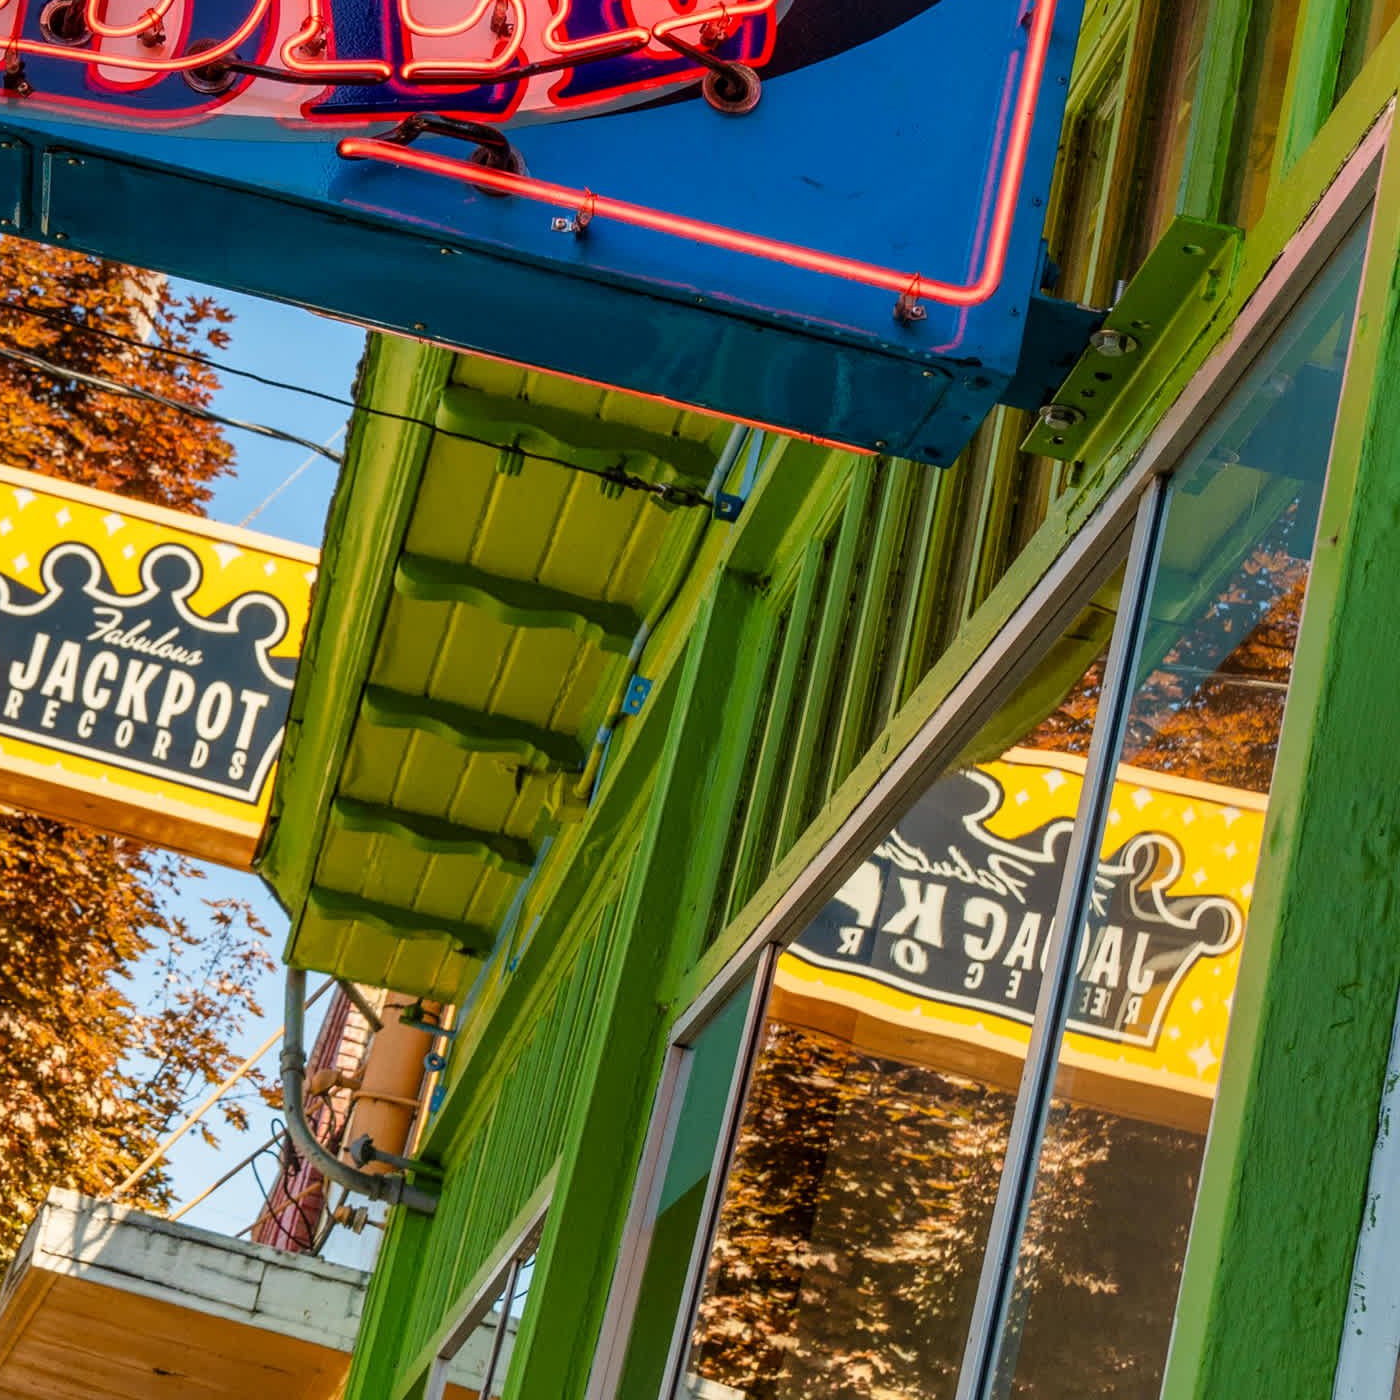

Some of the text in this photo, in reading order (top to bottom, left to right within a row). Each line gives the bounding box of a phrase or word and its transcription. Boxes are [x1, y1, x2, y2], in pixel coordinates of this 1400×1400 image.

[87, 606, 204, 666] Fabulous
[3, 688, 248, 781] RECORDS
[8, 632, 271, 751] JACKPOT
